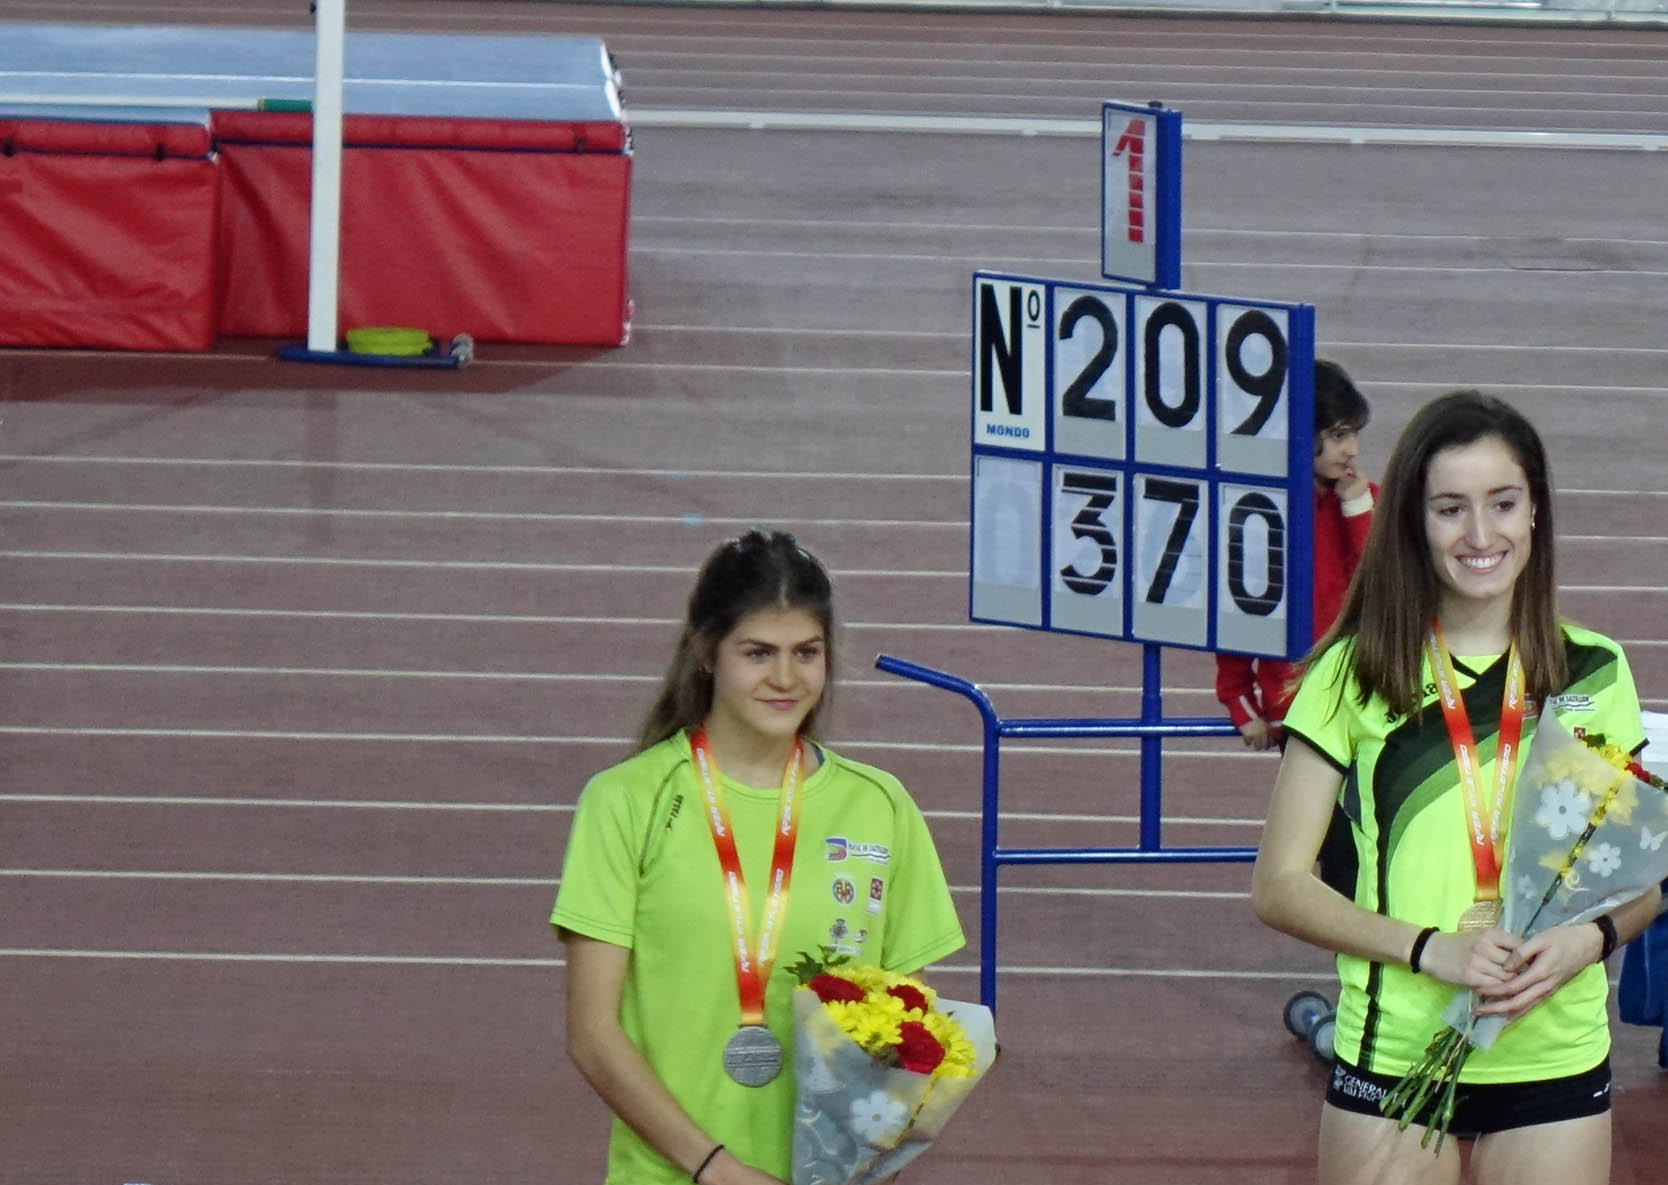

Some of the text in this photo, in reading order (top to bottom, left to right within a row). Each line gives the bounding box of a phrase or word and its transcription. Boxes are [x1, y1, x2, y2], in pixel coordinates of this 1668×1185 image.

[1112, 118, 1146, 244] 1
[986, 424, 1029, 438] MONDO
[1058, 295, 1287, 436] 209
[1060, 471, 1285, 616] 370
